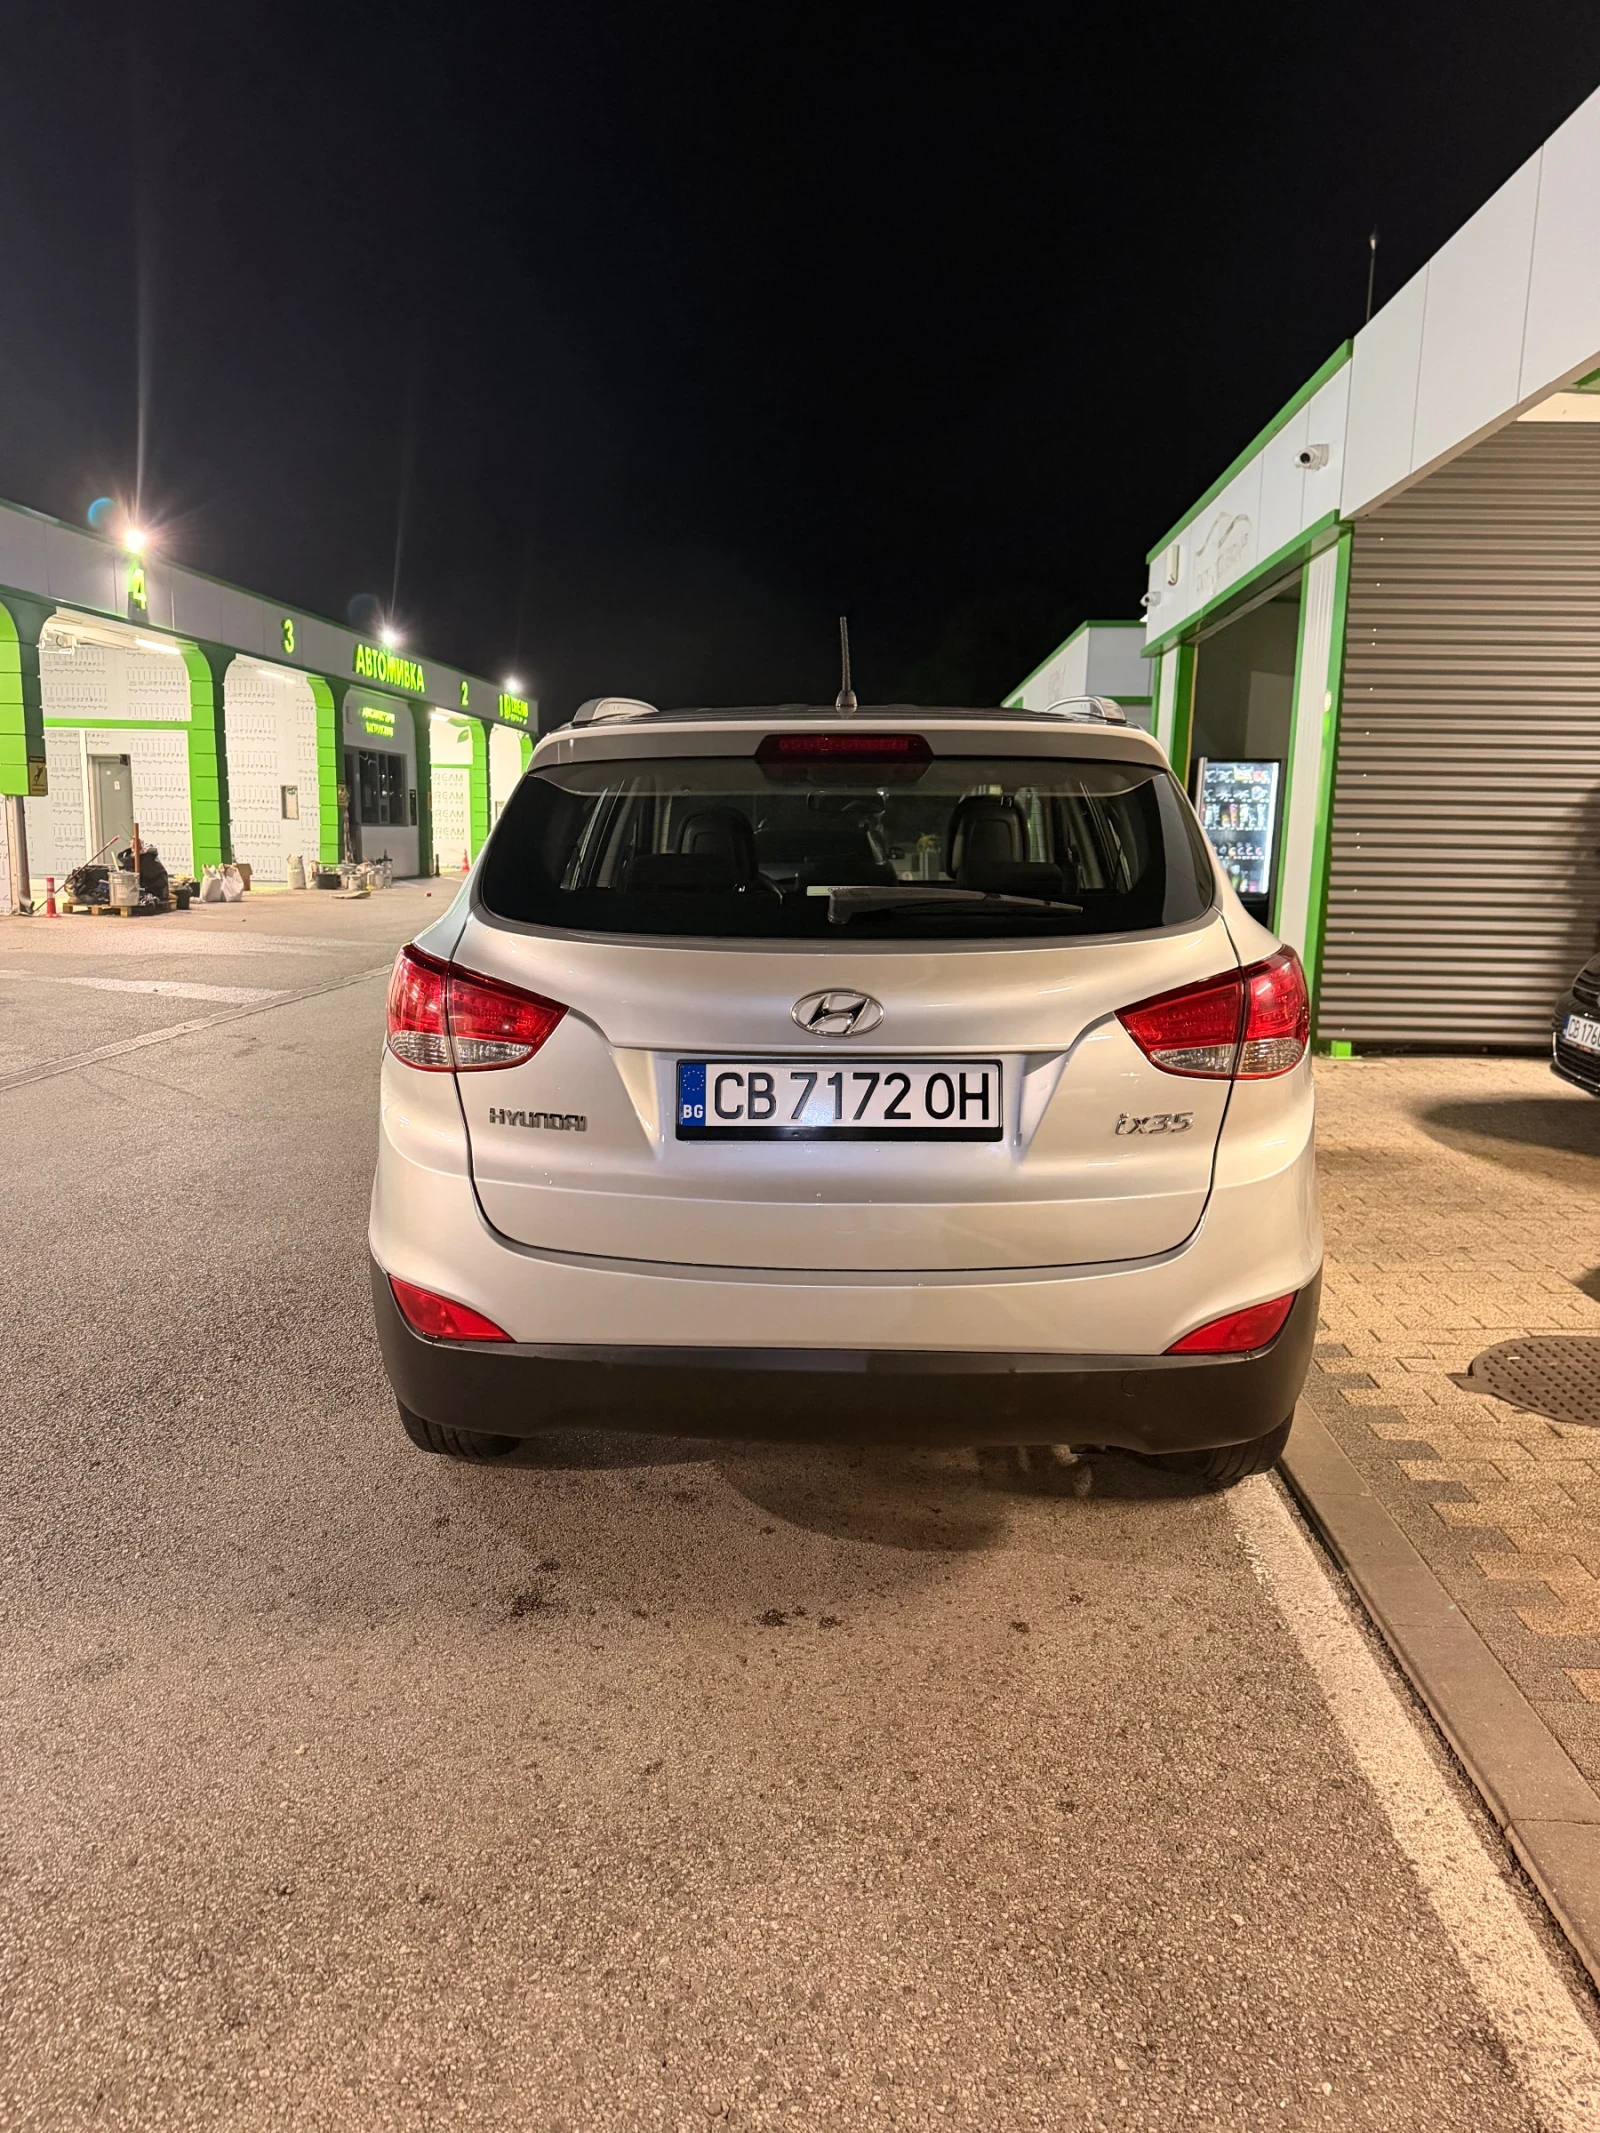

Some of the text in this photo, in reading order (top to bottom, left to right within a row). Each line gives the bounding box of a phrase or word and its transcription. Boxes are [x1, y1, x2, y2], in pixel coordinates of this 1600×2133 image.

[132, 568, 147, 610] 4
[283, 618, 295, 654] 3
[355, 643, 426, 693] АВТОМИВКА
[461, 681, 469, 706] 2
[434, 773, 464, 782] REAM
[434, 791, 464, 800] REAM
[435, 809, 465, 818] REAM
[436, 827, 465, 836] REAM
[1568, 1018, 1580, 1038] CB
[714, 1072, 990, 1120] CB 7172 OH
[489, 1107, 589, 1132] HYUNDAI
[682, 1104, 704, 1118] BG
[1114, 1111, 1195, 1135] ix35
